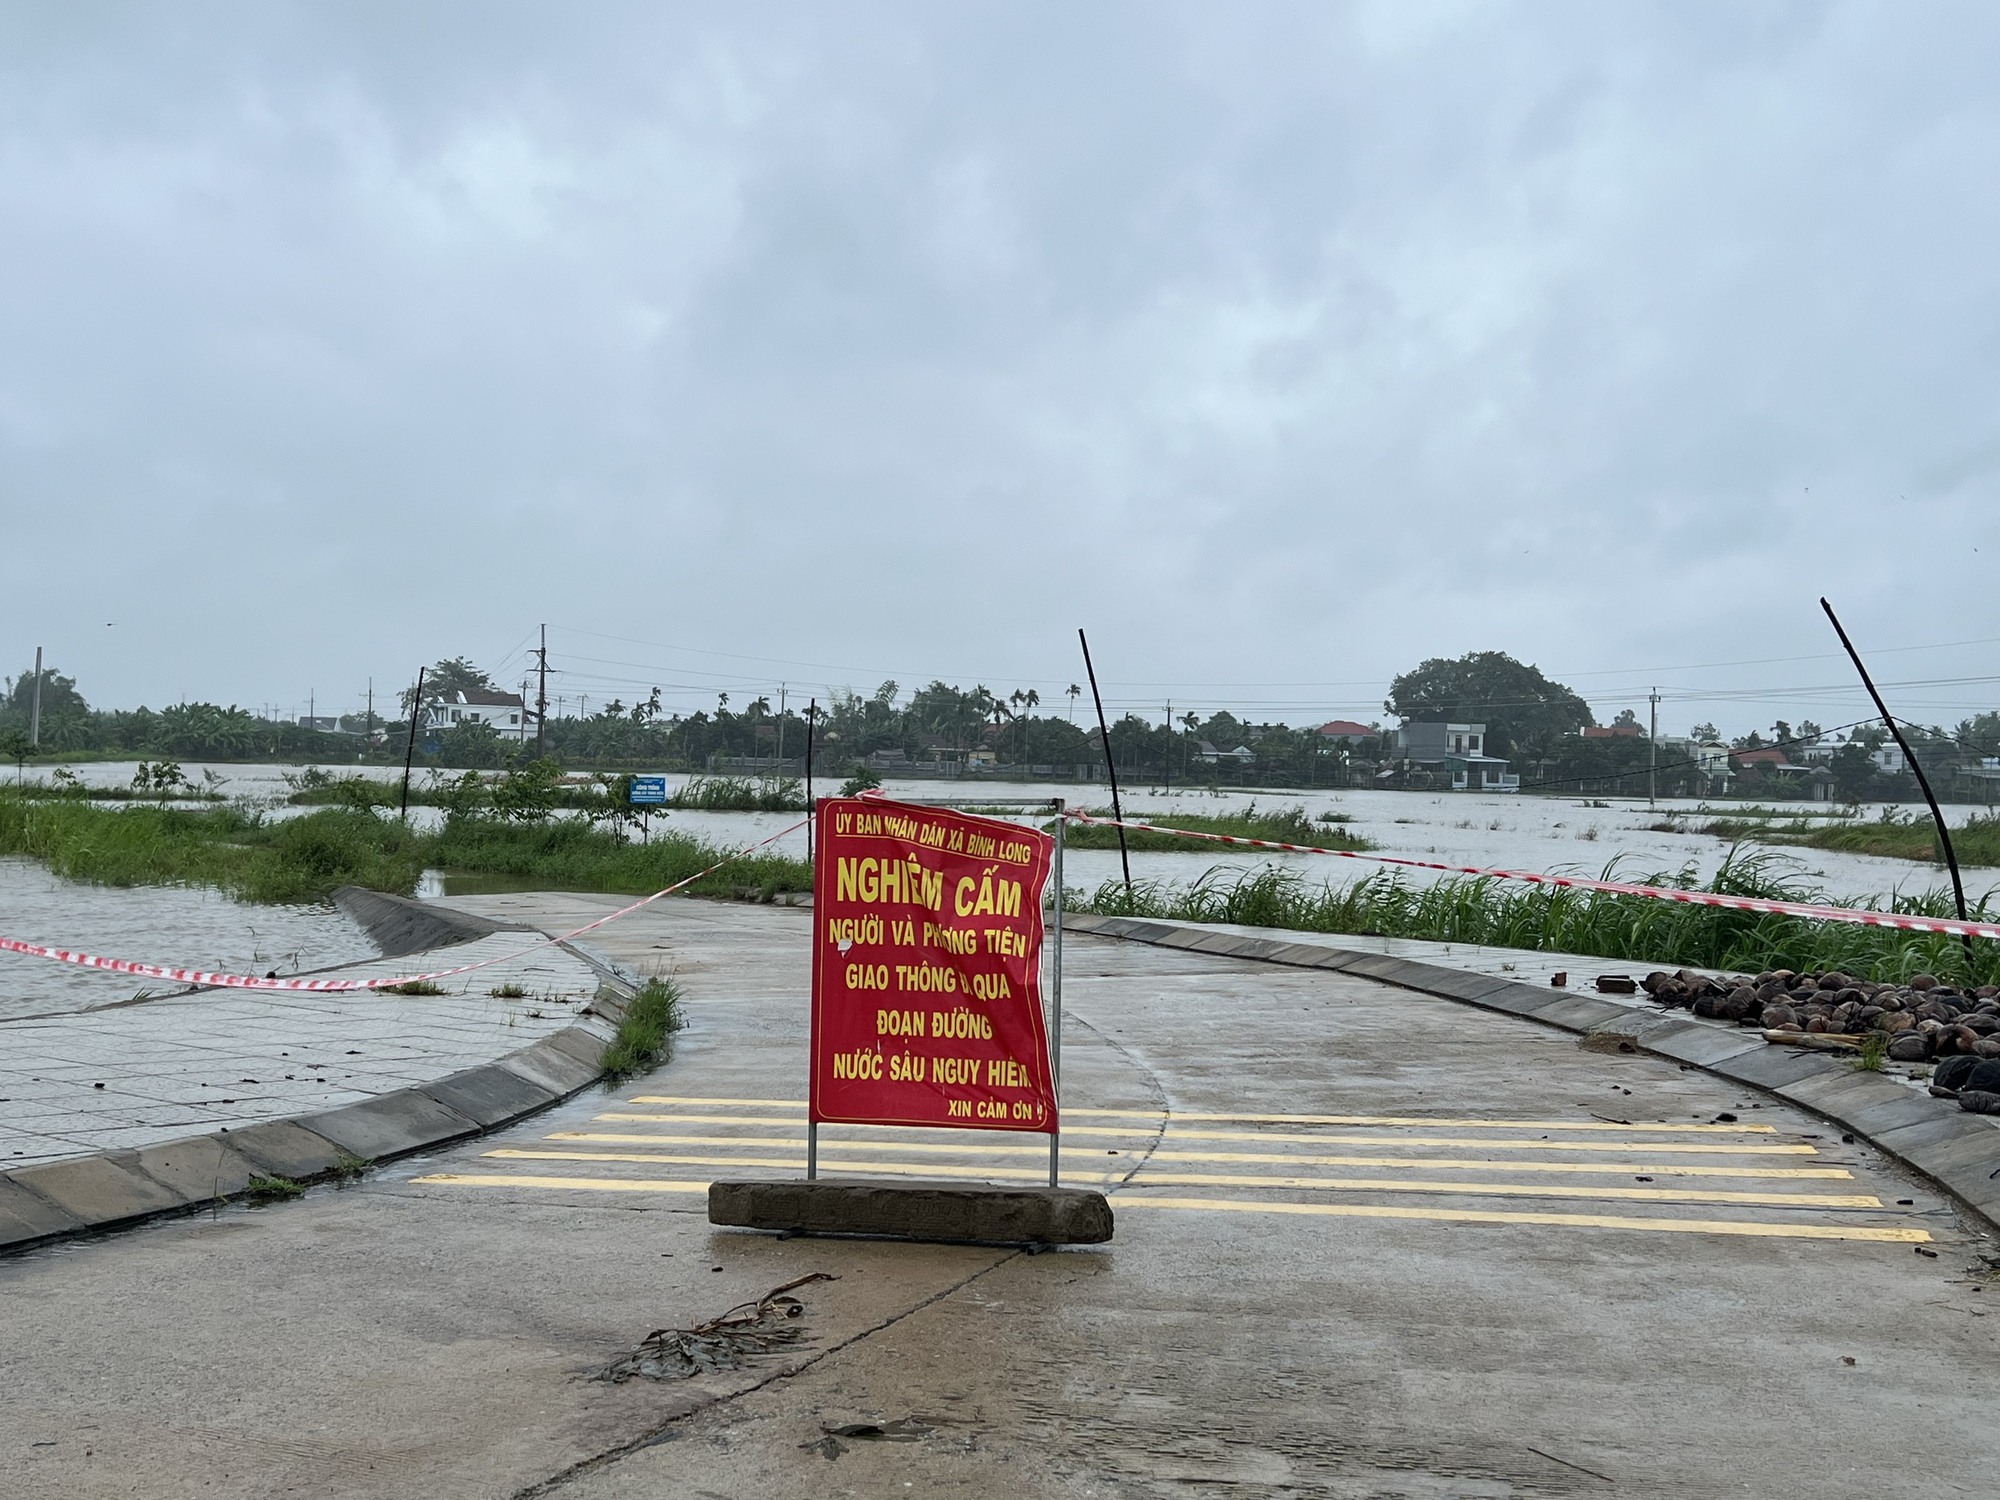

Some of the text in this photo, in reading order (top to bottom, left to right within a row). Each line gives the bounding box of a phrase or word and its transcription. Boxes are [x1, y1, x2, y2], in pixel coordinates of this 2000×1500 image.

[836, 806, 1032, 864] ỦY BAN NHÂN DÂN XÃ BÌNH LONG
[837, 852, 1022, 918] NGHIÊM CẤM
[829, 913, 884, 946] NGƯỜI
[891, 913, 916, 947] VÀ
[983, 925, 1026, 962] TIỆN
[845, 963, 889, 990] GIAO
[896, 960, 957, 993] THÔNG
[972, 973, 1011, 1002] QUA
[876, 1006, 993, 1043] ĐOẠN ĐƯỜNG
[833, 1047, 883, 1080] NƯỚC
[890, 1050, 925, 1082] SÂU
[932, 1057, 981, 1085] NGUY
[948, 1099, 972, 1117] XIN
[977, 1096, 1007, 1119] CẢM
[1012, 1100, 1033, 1120] ƠN
